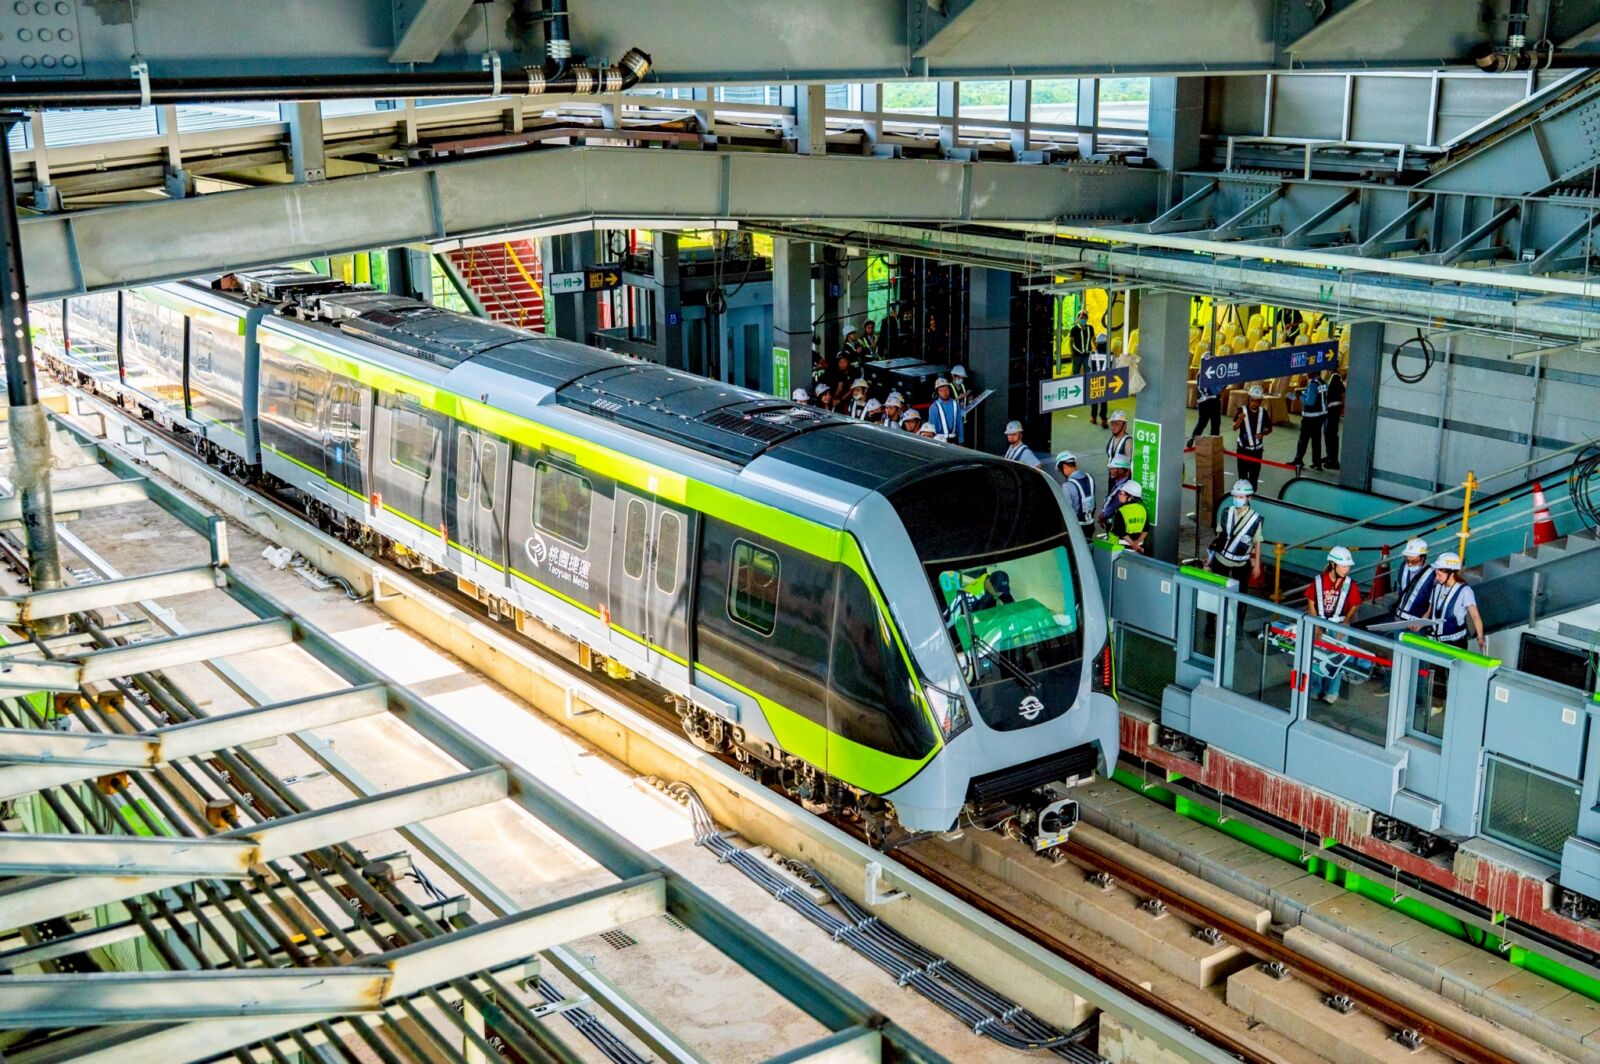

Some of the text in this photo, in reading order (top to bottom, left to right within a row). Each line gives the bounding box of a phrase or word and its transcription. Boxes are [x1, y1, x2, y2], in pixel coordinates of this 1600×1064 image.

[1090, 375, 1107, 390] 出口
[1090, 389, 1106, 399] EXIT
[1136, 429, 1156, 444] G13
[548, 544, 592, 580] 桃園捷運
[548, 562, 590, 590] Taoyuan Metro
